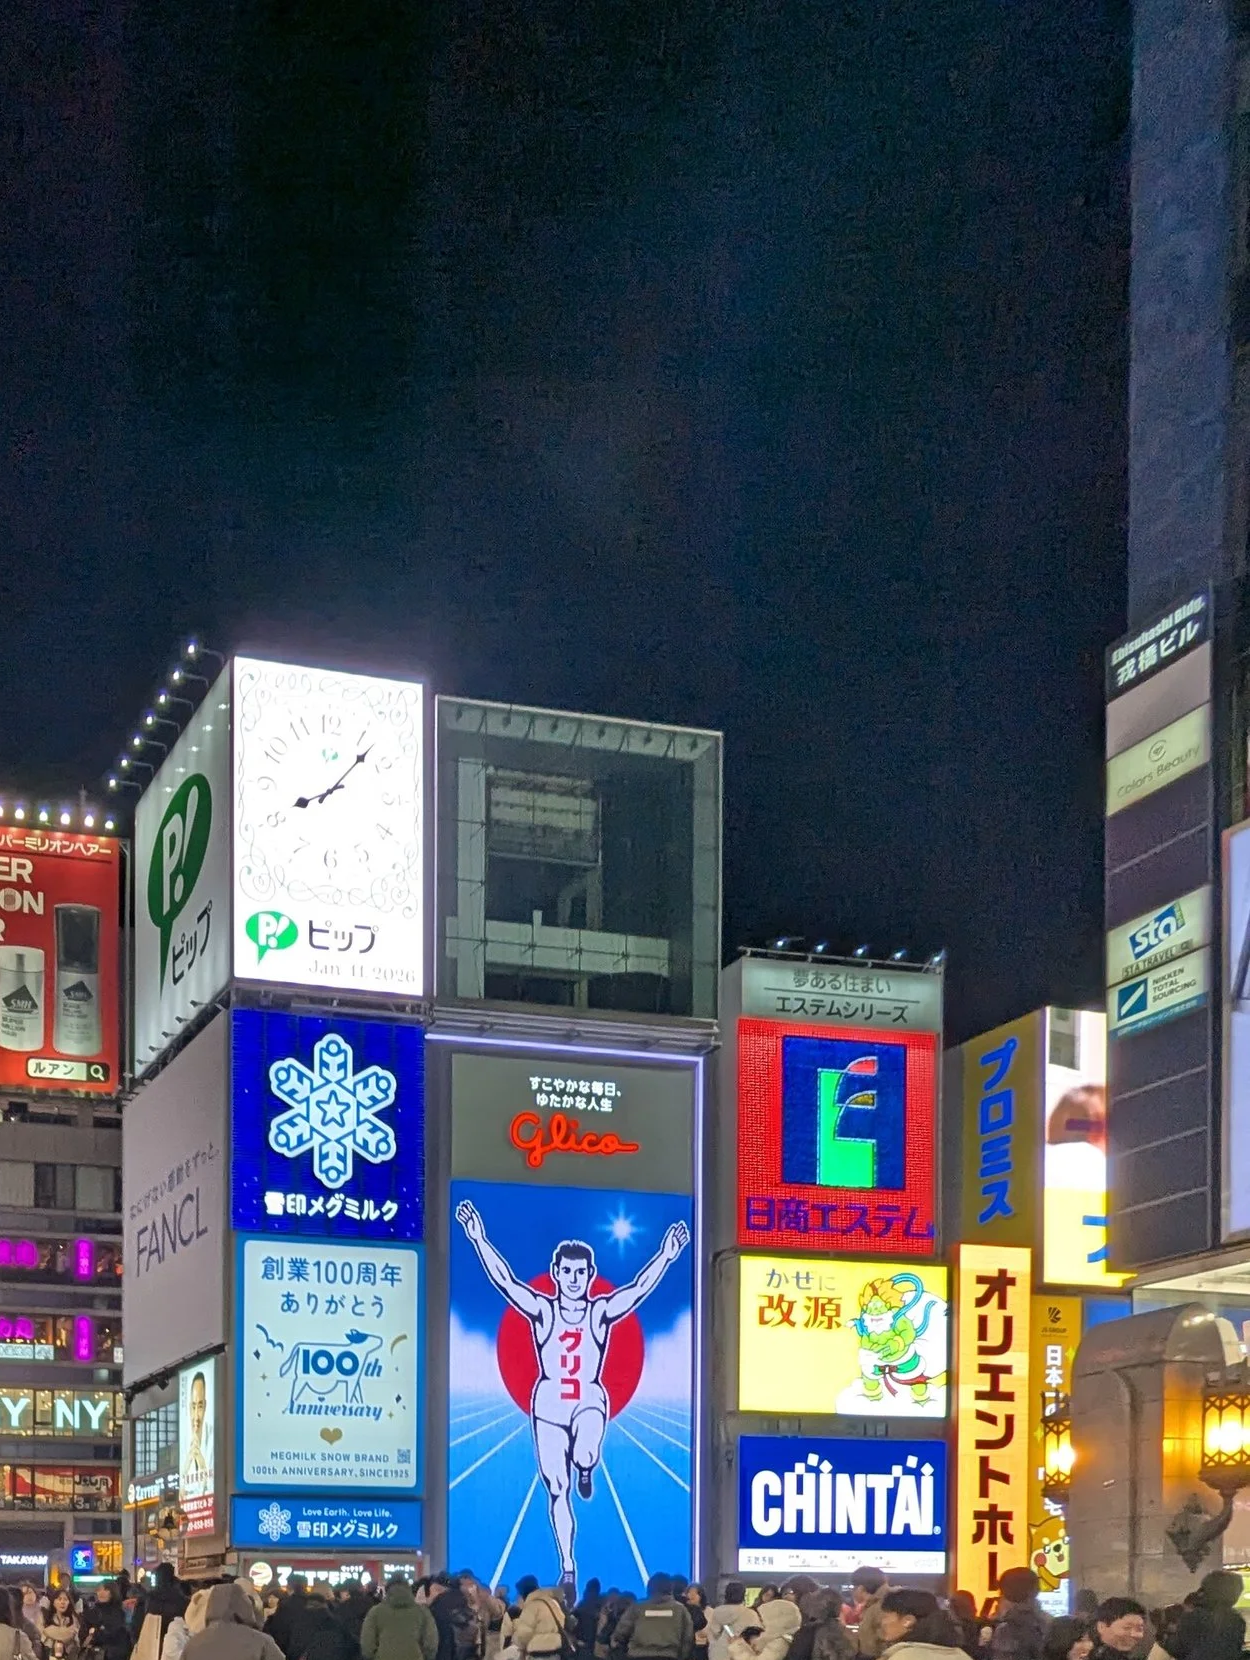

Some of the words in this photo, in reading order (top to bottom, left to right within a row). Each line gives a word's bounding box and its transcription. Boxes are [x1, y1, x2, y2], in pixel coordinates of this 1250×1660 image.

[1117, 620, 1200, 687] 戎橋ビル
[1117, 772, 1154, 797] Colors
[1157, 744, 1200, 777] Beauty
[172, 900, 213, 985] ピップ
[308, 920, 379, 954] ピップ
[1141, 949, 1175, 970] TRAVEL
[793, 967, 891, 994] 夢ある住まい
[1152, 966, 1185, 985] NIKKEN
[1152, 978, 1180, 993] TOTAL
[1152, 979, 1197, 1002] SOURCING
[775, 996, 909, 1024] エステムシリーズ
[33, 1062, 74, 1076] ルアン
[536, 1092, 613, 1112] ゆたかな人生
[511, 1111, 640, 1168] Glico
[977, 1035, 1019, 1226] プロミス
[264, 1191, 399, 1222] 雪印メグミルク
[745, 1196, 936, 1240] 日商エステム
[136, 1186, 208, 1278] FANCL
[261, 1256, 403, 1287] 創業100周年
[280, 1291, 384, 1319] ありがとう
[757, 1293, 844, 1331] 改源
[558, 1327, 583, 1401] グリコ
[53, 1398, 109, 1430] NY
[282, 1399, 383, 1421] Anniversary
[270, 1451, 316, 1462] MEGMILK
[320, 1452, 351, 1462] SNOW
[354, 1454, 390, 1464] BRAND
[971, 1268, 1017, 1619] オリエントホー
[252, 1466, 278, 1475] 100th
[751, 1452, 935, 1537] CHINTAI
[302, 1507, 322, 1517] Love
[323, 1507, 350, 1517] Earth.
[353, 1508, 372, 1518] Love
[374, 1508, 393, 1518] Life.
[297, 1519, 399, 1539] 雪印メグミルク
